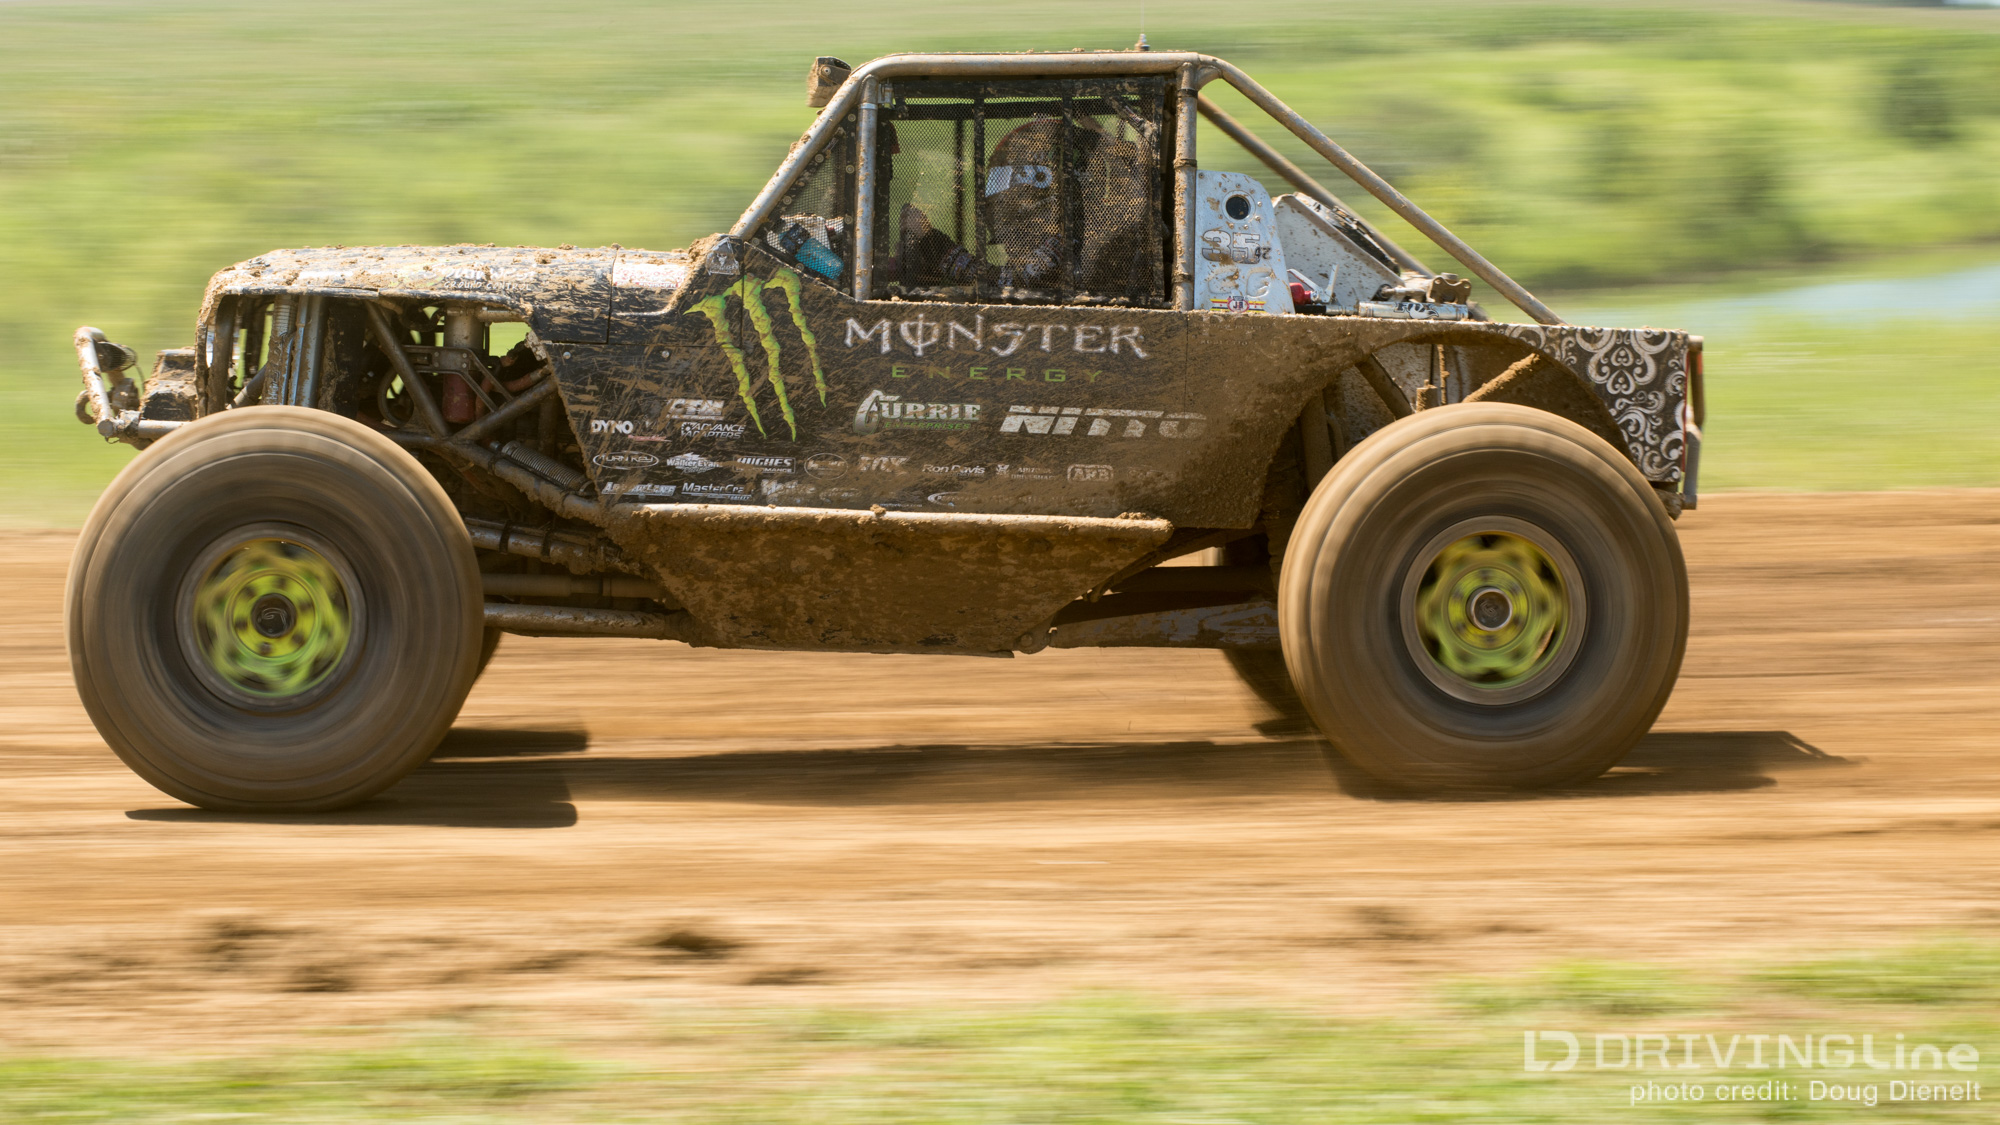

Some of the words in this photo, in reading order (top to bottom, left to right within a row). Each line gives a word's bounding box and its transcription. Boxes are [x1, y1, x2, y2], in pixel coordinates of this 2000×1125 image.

[1202, 230, 1260, 264] 35
[443, 280, 481, 289] GROUND
[485, 281, 532, 291] CONTROL
[844, 313, 1148, 359] MONSTER
[891, 364, 1102, 383] ENERGY
[853, 389, 981, 435] CURRIE
[884, 421, 971, 430] ENTERPRISES
[999, 405, 1207, 439] NITTO
[666, 458, 698, 468] Walker
[698, 460, 723, 468] Evan
[736, 457, 793, 467] HUGHES
[921, 464, 949, 473] Ron
[682, 482, 755, 494] MasterCra
